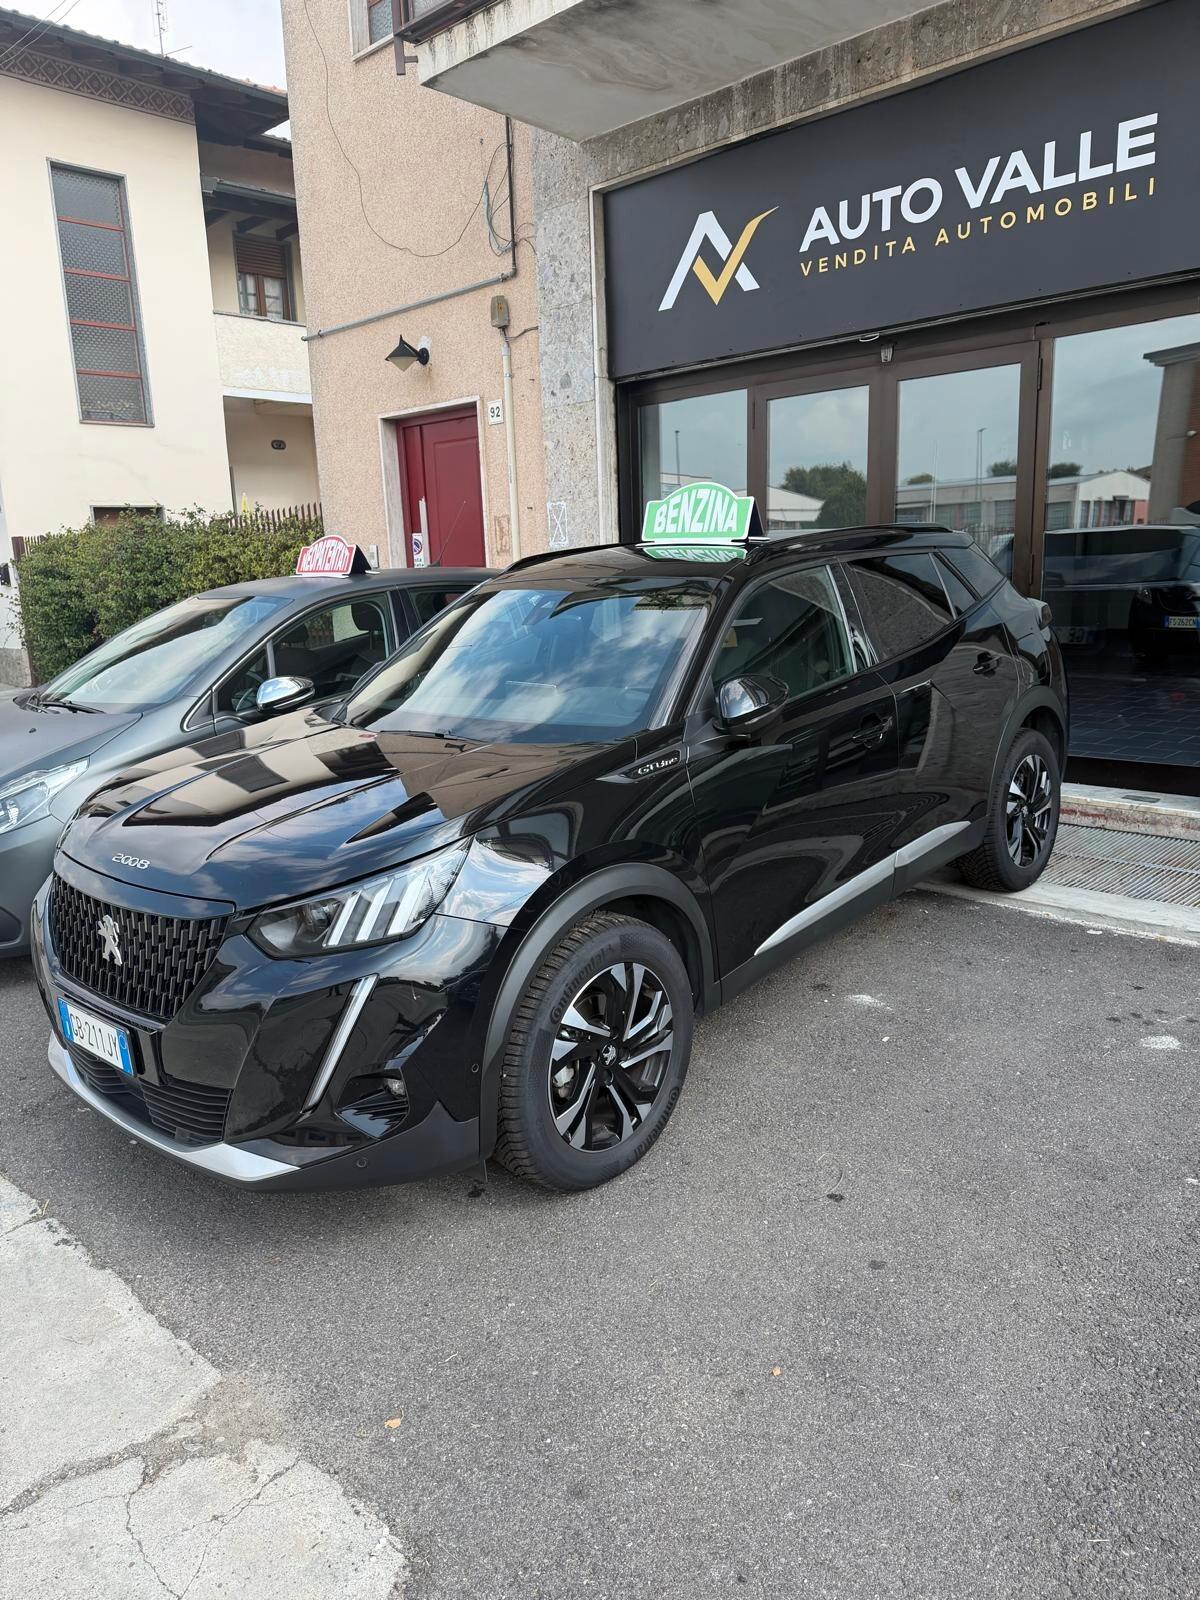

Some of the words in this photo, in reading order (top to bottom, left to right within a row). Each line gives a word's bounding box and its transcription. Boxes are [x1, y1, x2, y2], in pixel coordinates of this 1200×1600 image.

[799, 177, 943, 253] AUTO
[954, 112, 1159, 210] VALLE
[800, 236, 916, 277] VENDITA
[934, 177, 1156, 247] AUTOMOBILI
[490, 406, 501, 418] 92
[654, 489, 737, 533] BENZINA
[112, 853, 150, 869] 2008
[550, 948, 606, 1025] Continental
[634, 1087, 680, 1158] Continental
